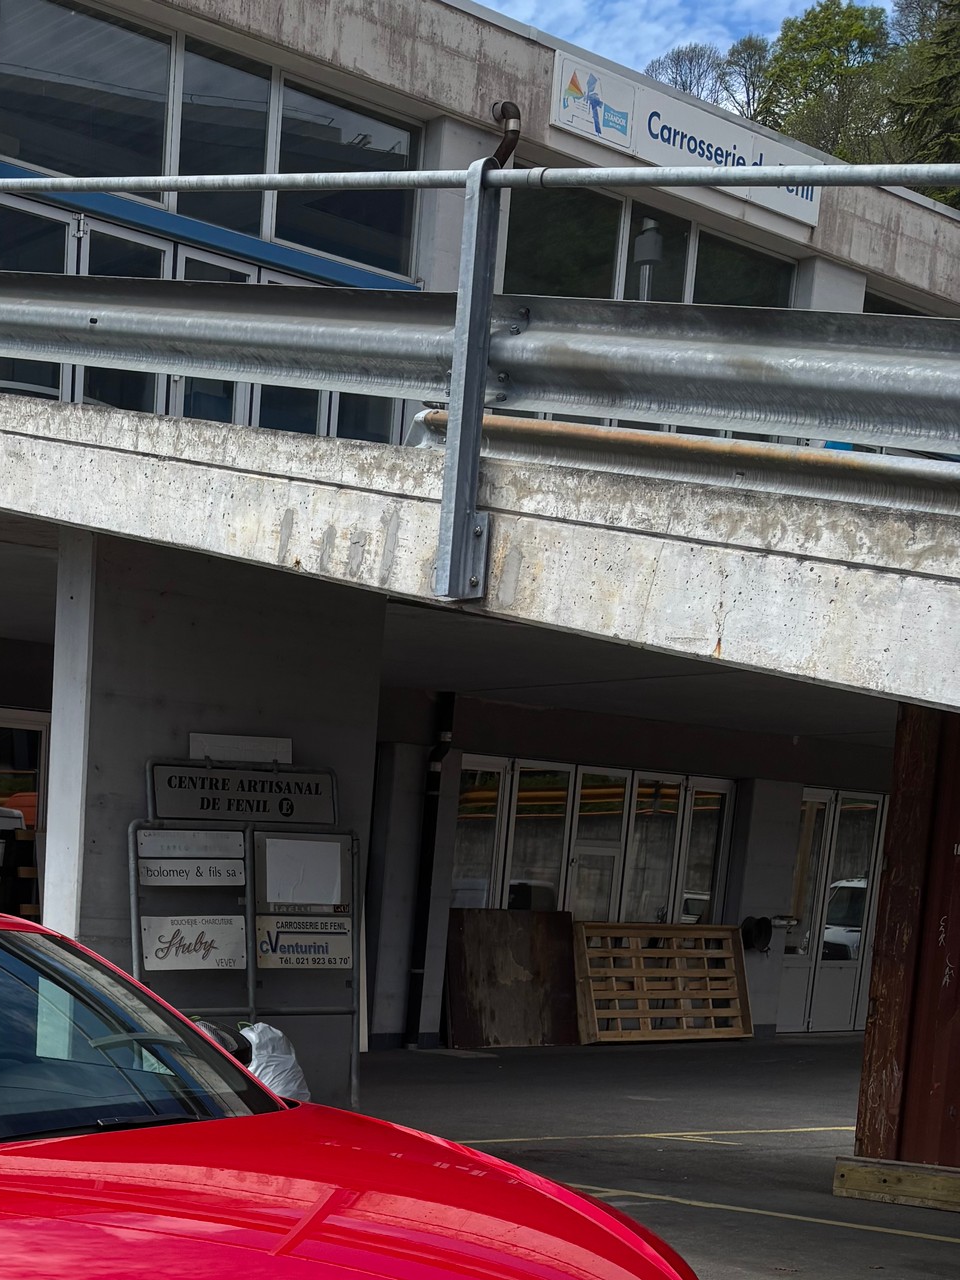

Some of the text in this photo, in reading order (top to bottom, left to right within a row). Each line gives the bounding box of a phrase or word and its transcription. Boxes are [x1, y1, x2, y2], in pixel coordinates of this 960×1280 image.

[648, 111, 746, 167] Carrosserie
[167, 775, 323, 796] CENTRE ARTISANAL
[199, 796, 221, 811] DE
[226, 798, 271, 813] FENIL
[146, 866, 237, 881] bolomey & fils sa
[276, 921, 347, 931] CARROSSERIE DE FENIL
[215, 958, 237, 967] VEVEY
[296, 957, 309, 965] 021
[312, 957, 326, 965] 923
[328, 957, 337, 965] 63
[340, 957, 348, 965] 70
